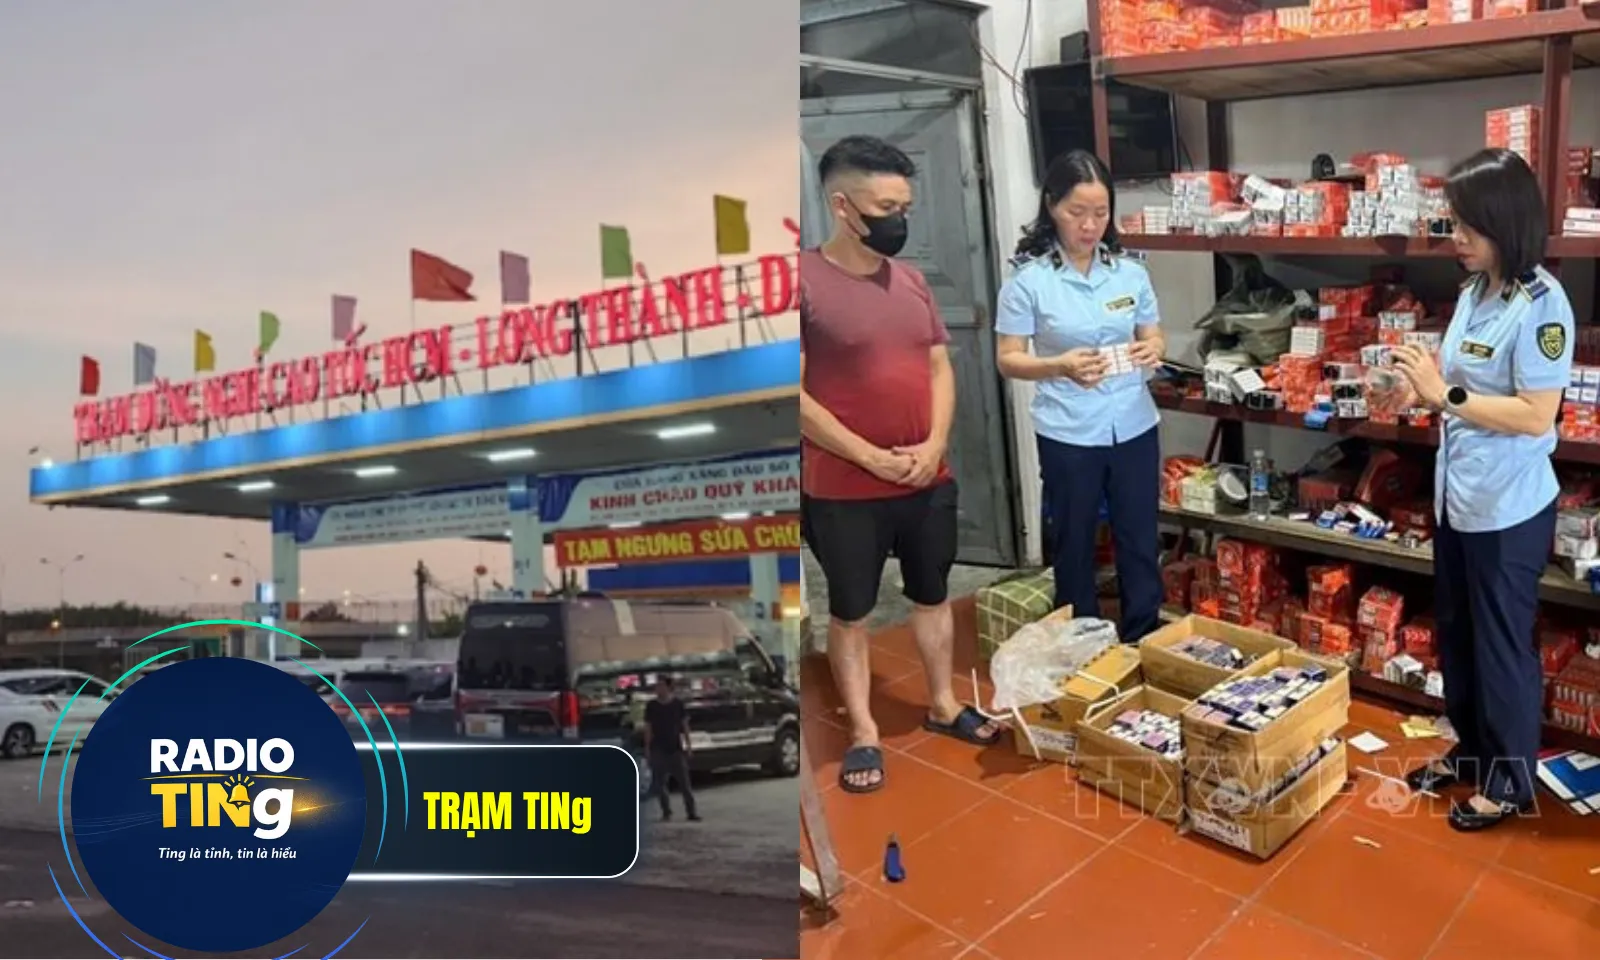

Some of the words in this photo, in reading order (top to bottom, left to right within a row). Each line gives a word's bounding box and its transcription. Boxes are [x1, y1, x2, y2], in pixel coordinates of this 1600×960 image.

[267, 357, 321, 410] CAO
[382, 324, 455, 388] HCM
[476, 299, 575, 370] LONG
[578, 261, 727, 350] THÀNH
[752, 473, 800, 495] KHÁ
[564, 537, 610, 565] TẠM
[699, 520, 749, 552] SỬA
